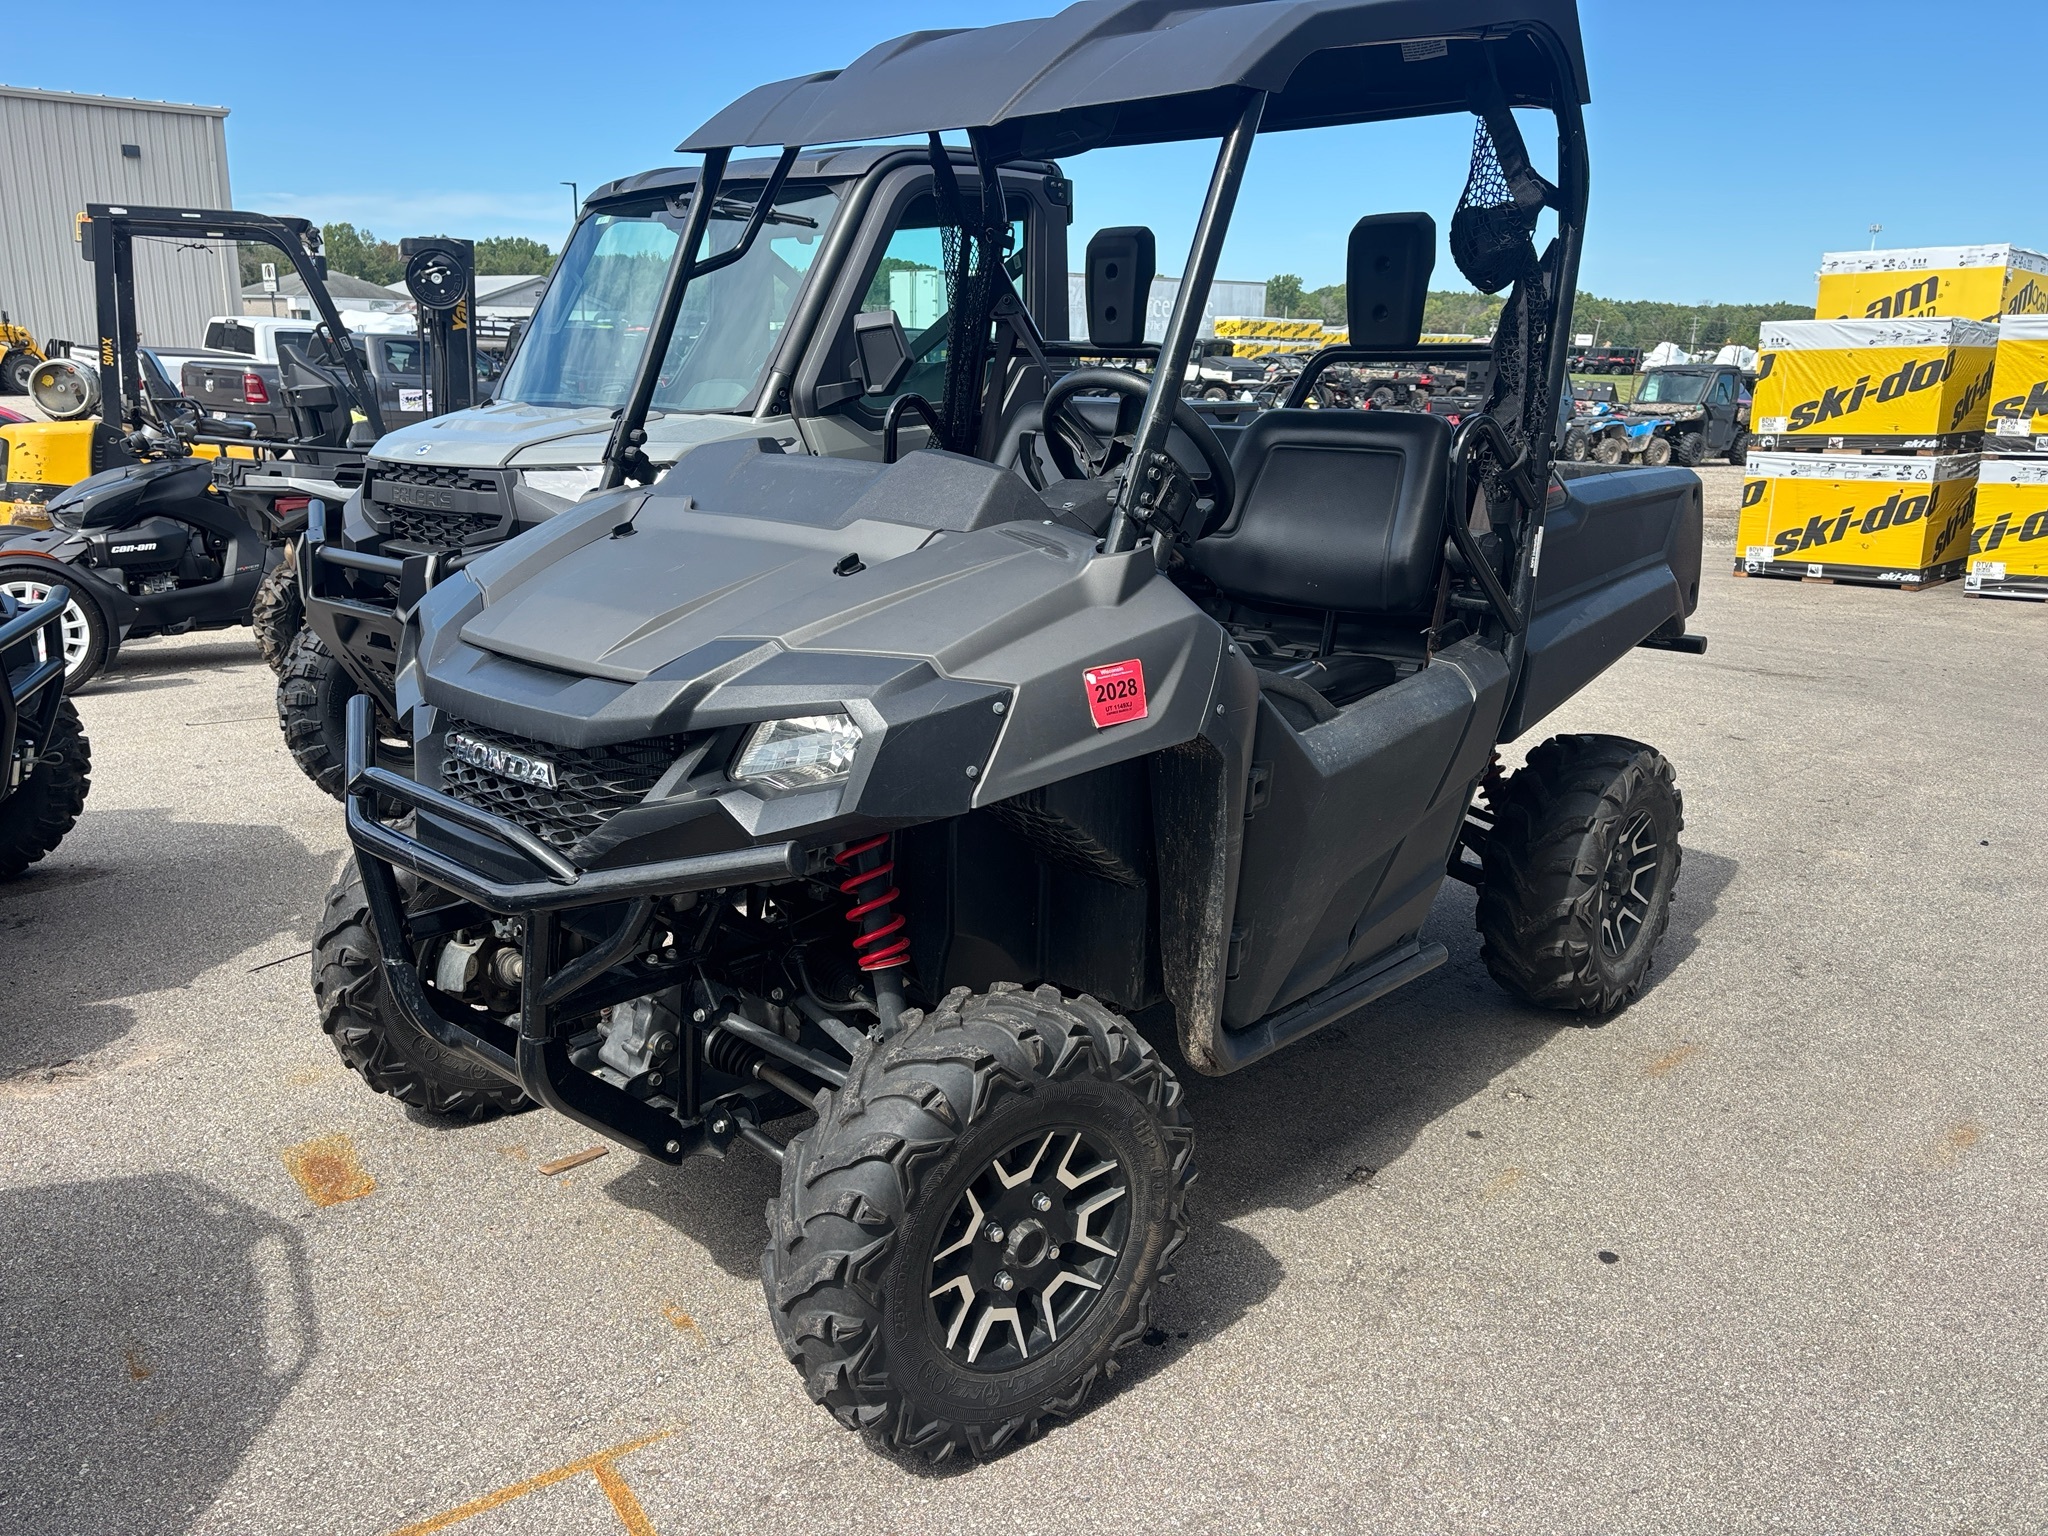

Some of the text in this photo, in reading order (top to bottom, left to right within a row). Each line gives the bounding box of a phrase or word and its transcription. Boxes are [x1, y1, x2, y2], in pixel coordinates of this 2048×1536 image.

[102, 337, 114, 367] 50MX
[1786, 349, 1956, 432] ski-doo
[392, 486, 452, 509] POLARIS
[1773, 484, 1939, 557] ski-doo
[111, 543, 157, 554] can-am
[1095, 678, 1138, 703] 2028
[455, 734, 557, 791] HONDA
